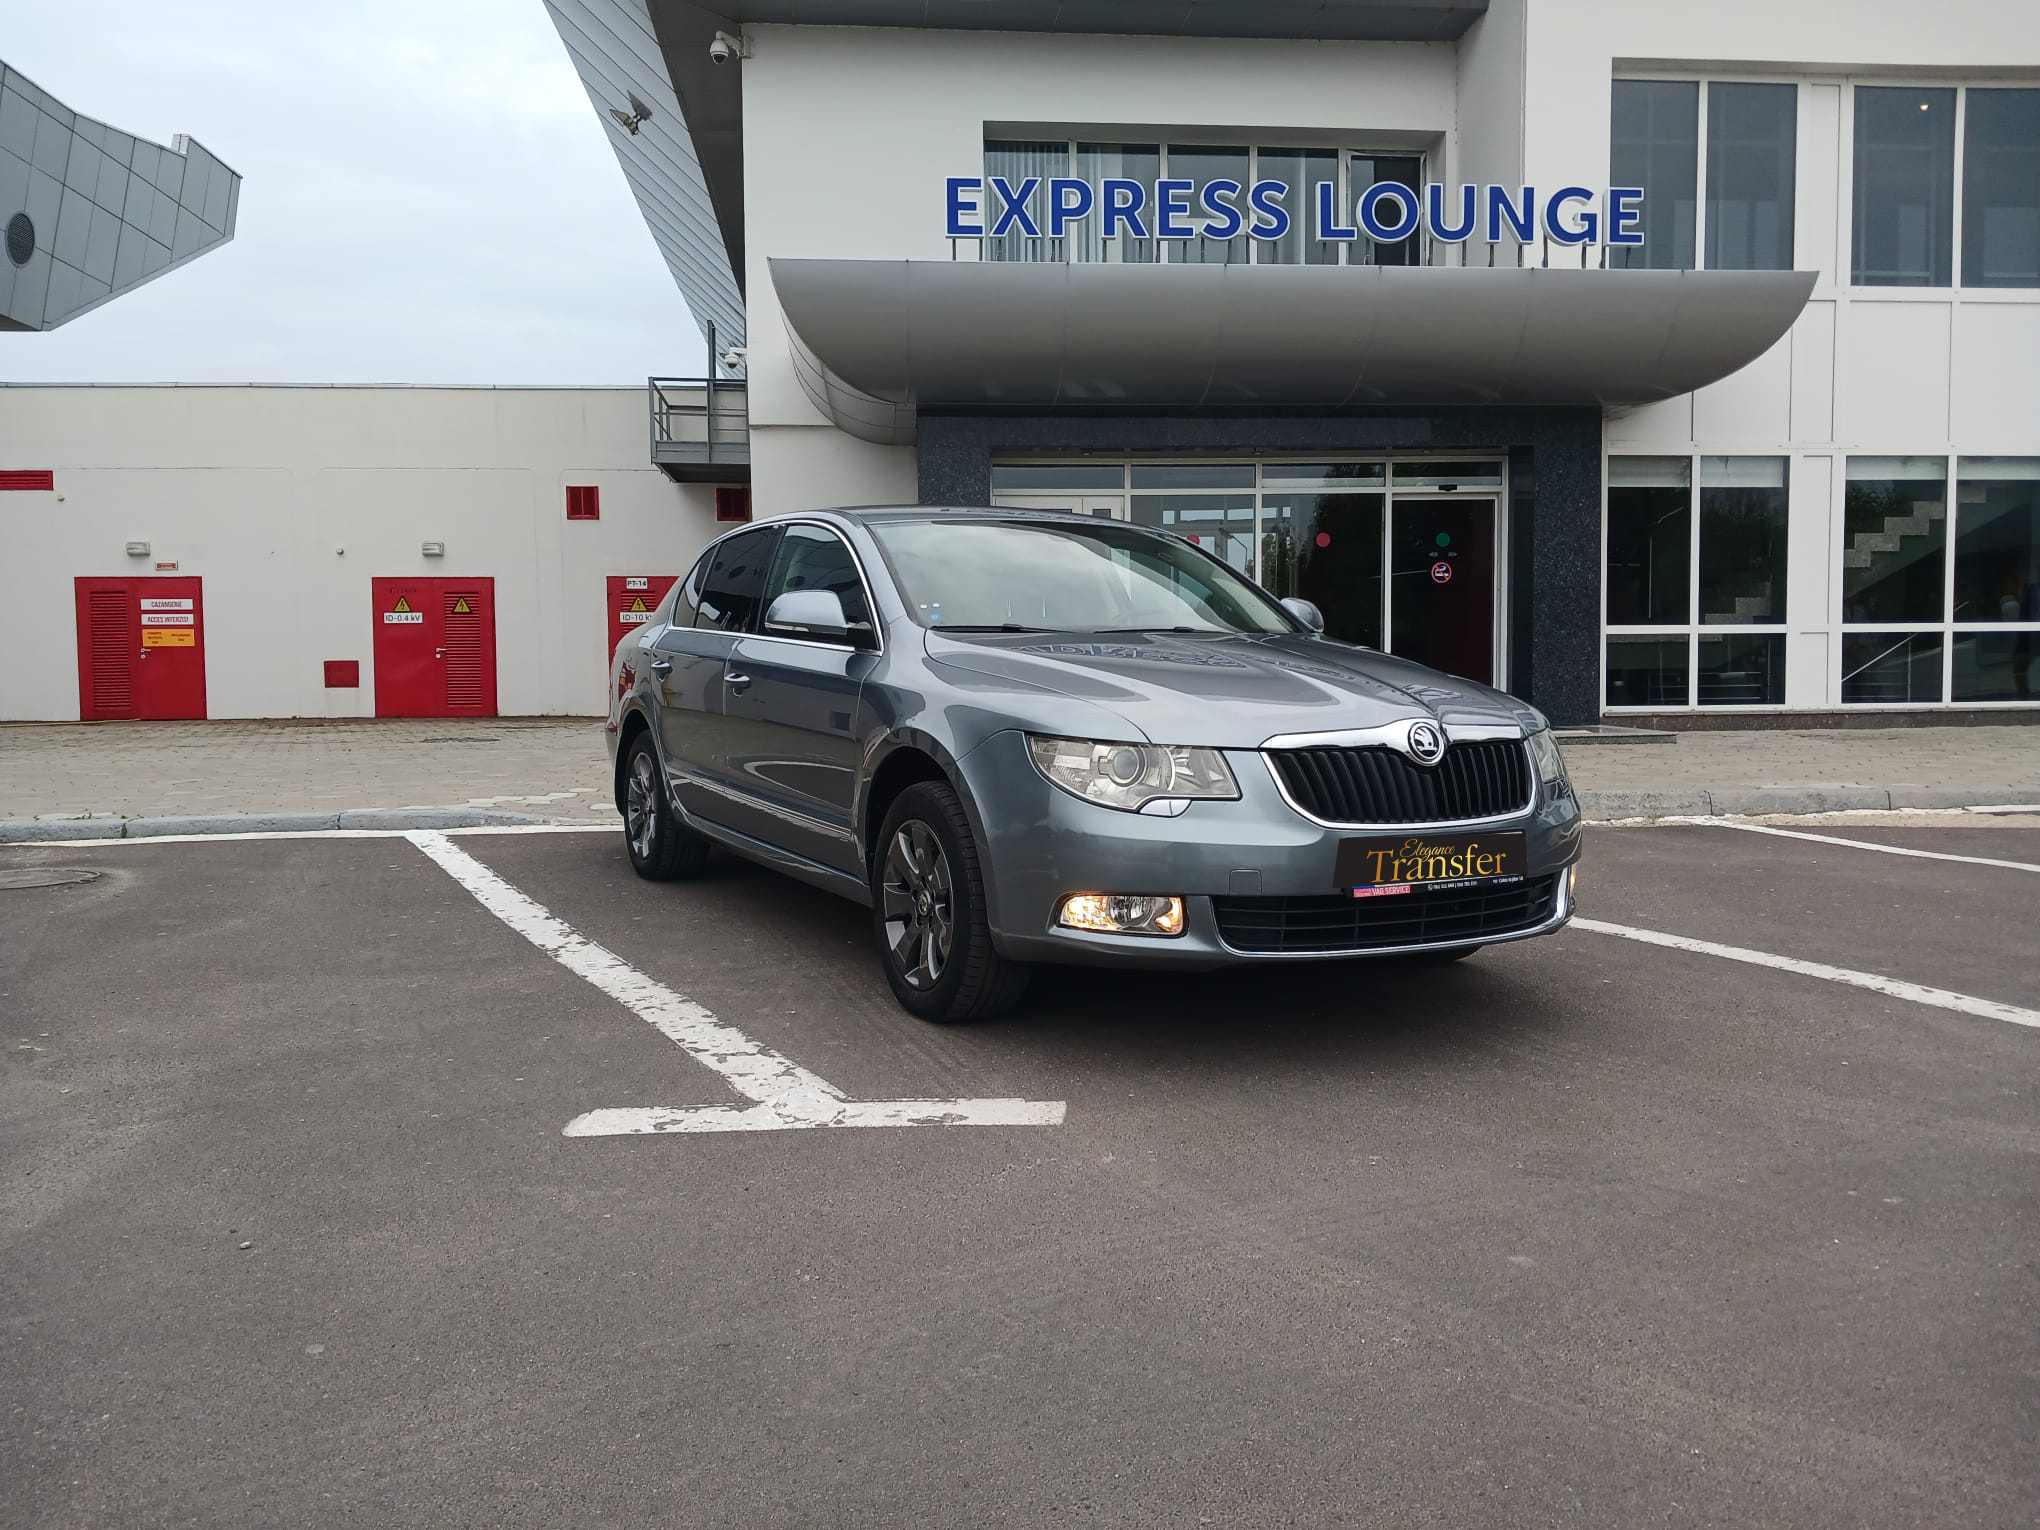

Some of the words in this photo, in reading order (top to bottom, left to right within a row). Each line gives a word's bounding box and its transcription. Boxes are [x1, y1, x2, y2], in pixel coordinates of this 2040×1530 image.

[945, 177, 1290, 241] EXPRESS
[1316, 181, 1645, 246] LOUNGE
[622, 613, 644, 622] ID-10
[1366, 843, 1507, 883] Transfer
[1400, 838, 1456, 862] Elegance
